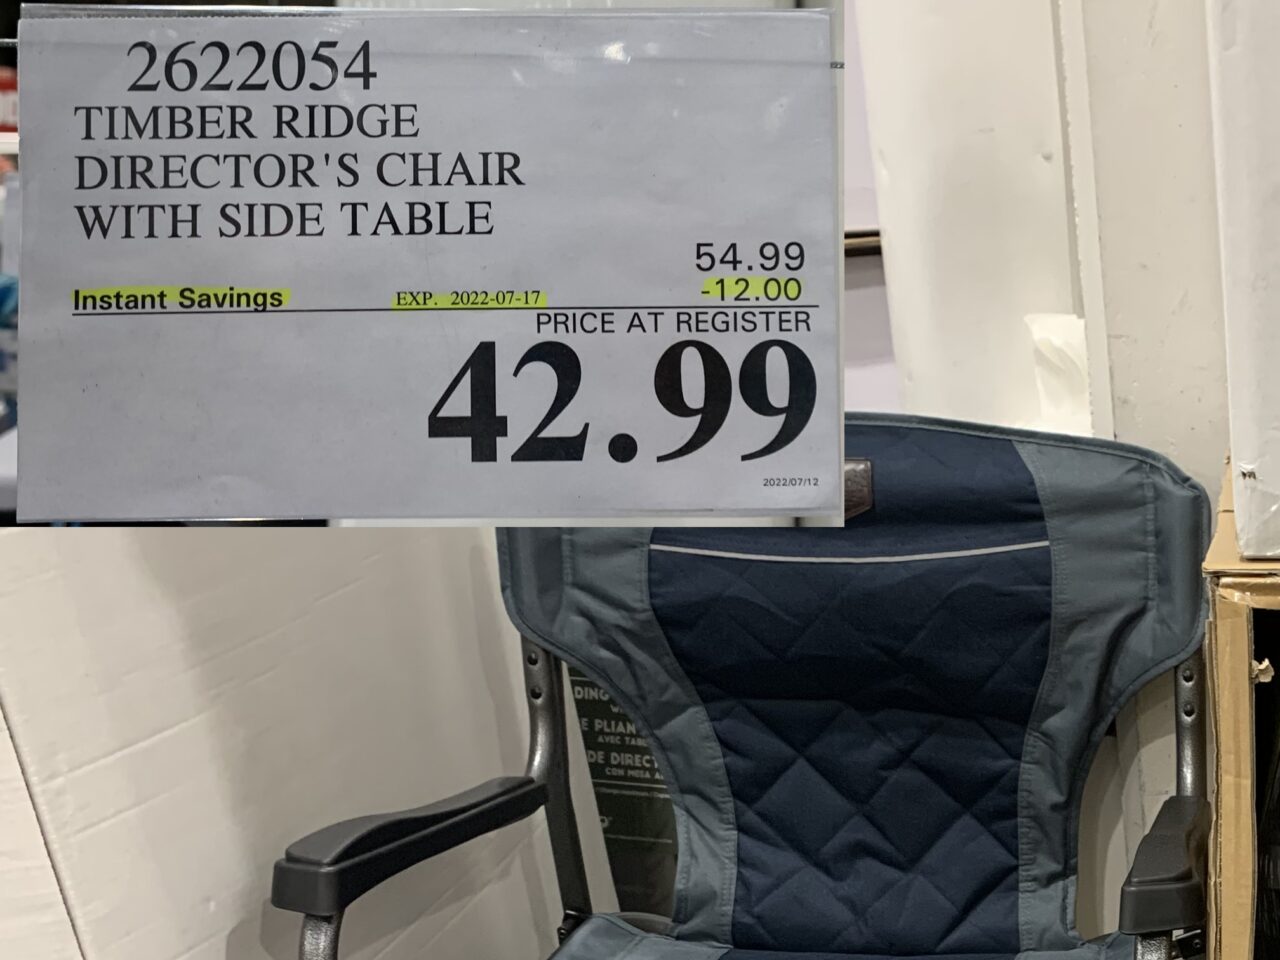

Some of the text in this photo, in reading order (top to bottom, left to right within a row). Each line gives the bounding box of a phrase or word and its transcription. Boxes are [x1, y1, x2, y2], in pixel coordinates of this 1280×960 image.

[127, 40, 378, 92] 2622054
[74, 103, 419, 140] TIMBER RIDGE
[75, 152, 525, 190] DIRECTOR'S CHAIR
[74, 201, 494, 240] WITH SIDE TABLE
[695, 241, 805, 272] 54.99
[73, 287, 284, 312] Instant Savings
[396, 290, 541, 306] EXP. 2022-07-17
[700, 277, 802, 302] -12.00
[536, 311, 811, 334] PRICE AT REGISTER
[427, 339, 817, 464] 42.99
[763, 477, 819, 487] 2022/07/12
